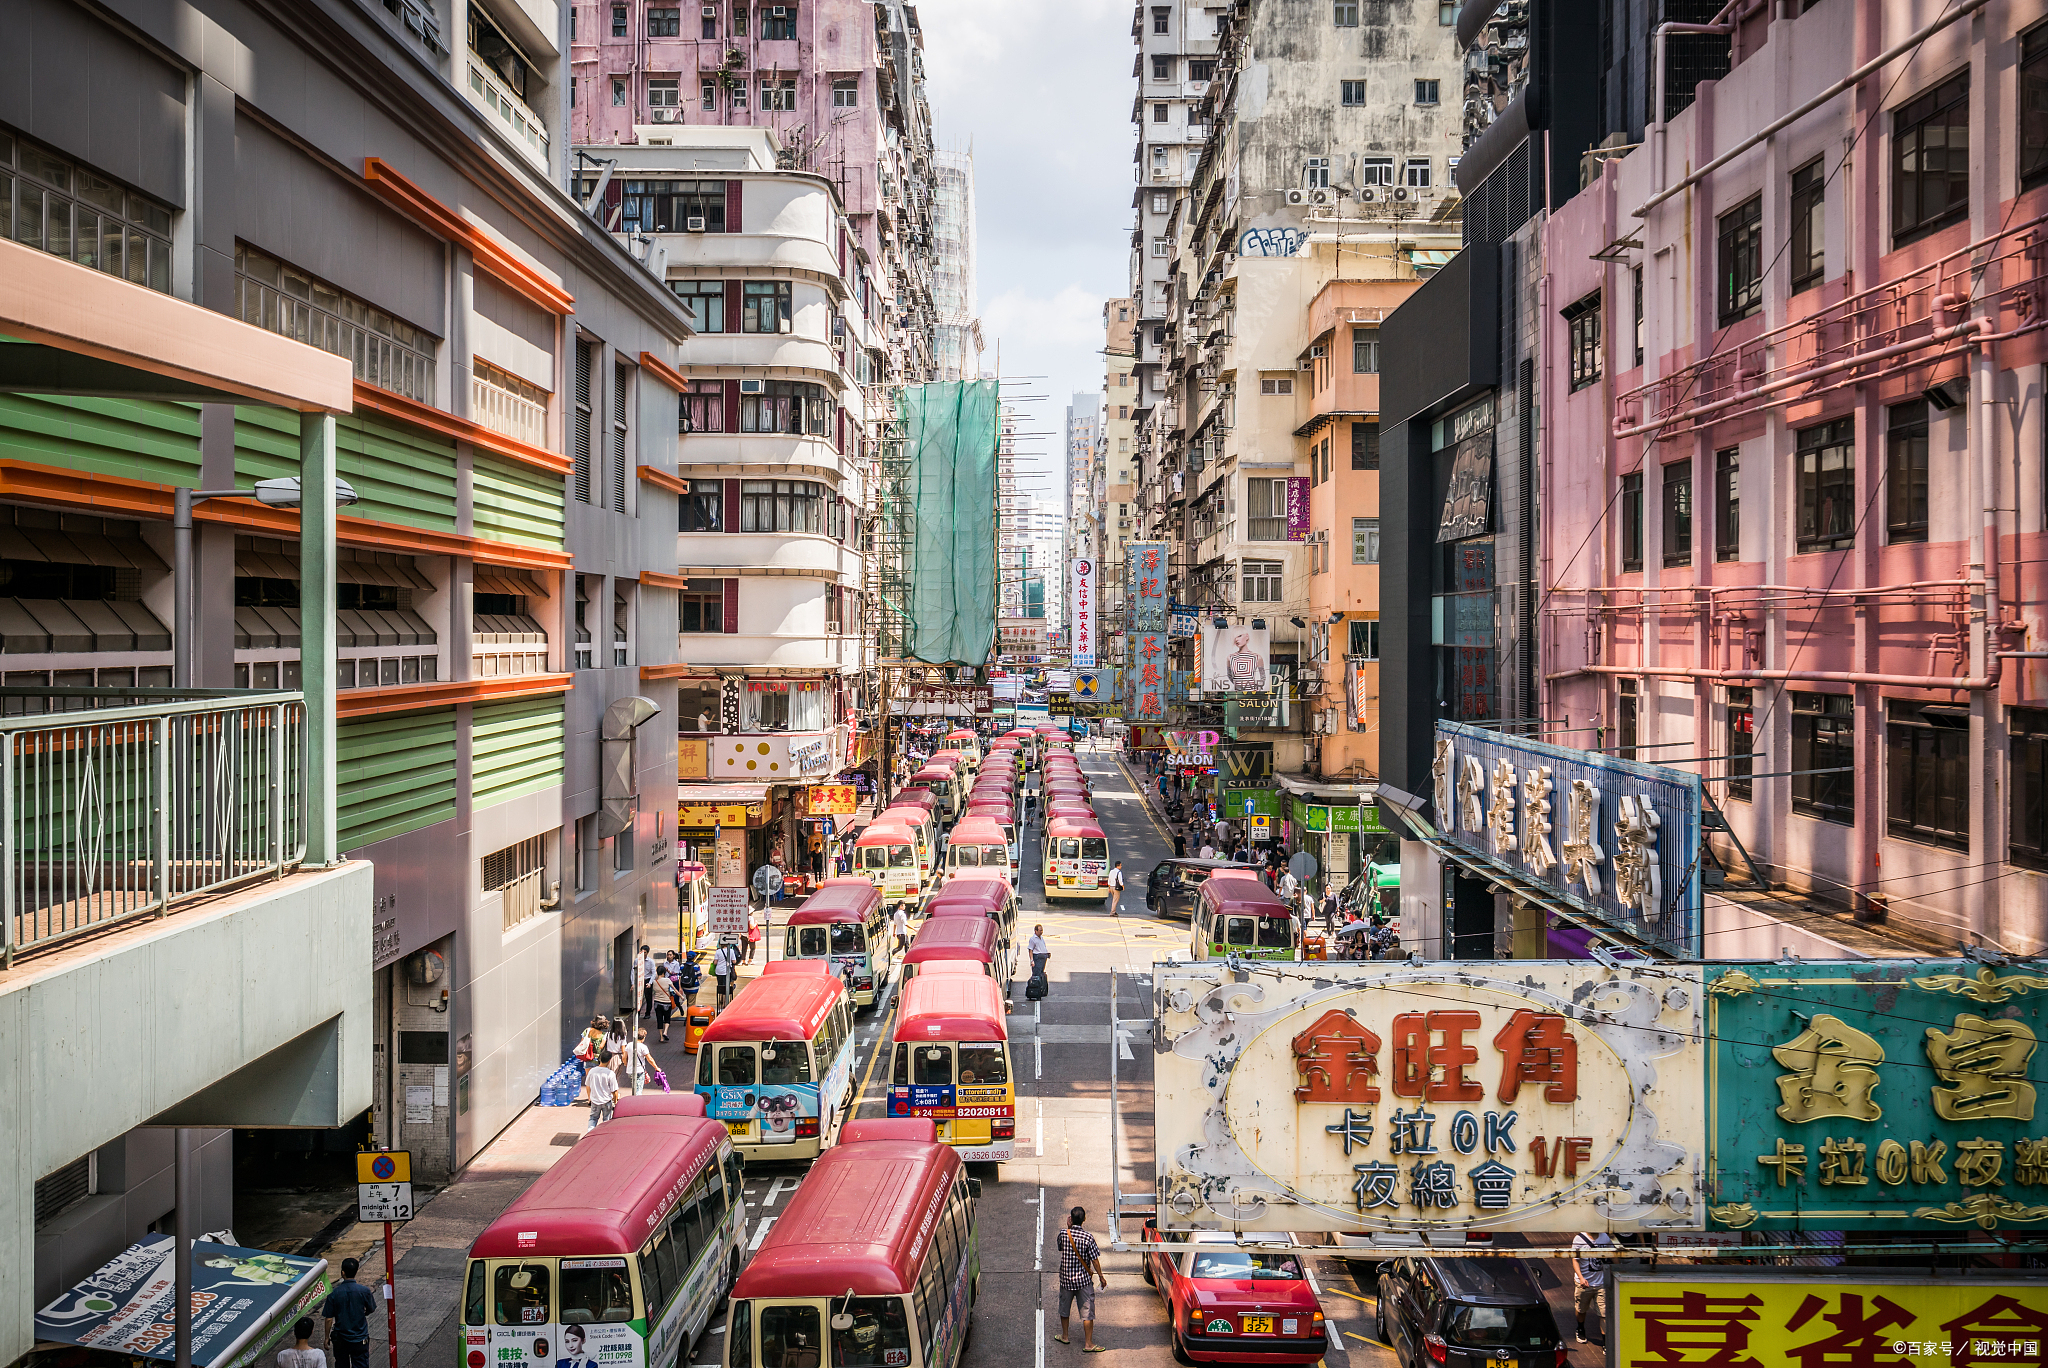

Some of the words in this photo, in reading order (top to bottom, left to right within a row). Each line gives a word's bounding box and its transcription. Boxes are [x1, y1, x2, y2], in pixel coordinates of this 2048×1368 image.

[1140, 549, 1162, 598] 澤記
[1139, 635, 1163, 715] 茶餐廳
[748, 682, 787, 692] SALON
[1239, 700, 1278, 708] SALON
[680, 743, 698, 763] 祥
[1167, 754, 1213, 766] SALON
[810, 787, 855, 804] 海天堂
[1334, 809, 1379, 822] 宏康醫
[1292, 1008, 1578, 1104] 金旺角
[922, 1109, 932, 1117] 24
[957, 1107, 1008, 1116] 82020811
[1326, 1107, 1518, 1155] 卡拉OK
[971, 1151, 990, 1160] 3526
[991, 1150, 1009, 1159] 0593
[1529, 1135, 1593, 1178] 1/F
[391, 1184, 400, 1198] 7
[1353, 1158, 1518, 1211] 夜總會
[367, 1190, 383, 1198] 上午
[368, 1211, 383, 1219] 午夜
[392, 1204, 409, 1218] 12
[1666, 1235, 1733, 1247] 而不予警告
[1250, 1317, 1266, 1325] FE
[1247, 1324, 1269, 1332] 327
[123, 1322, 176, 1354] 2388
[598, 1351, 614, 1360] 2111
[615, 1351, 633, 1360] 0998
[886, 1350, 907, 1364] 旺角
